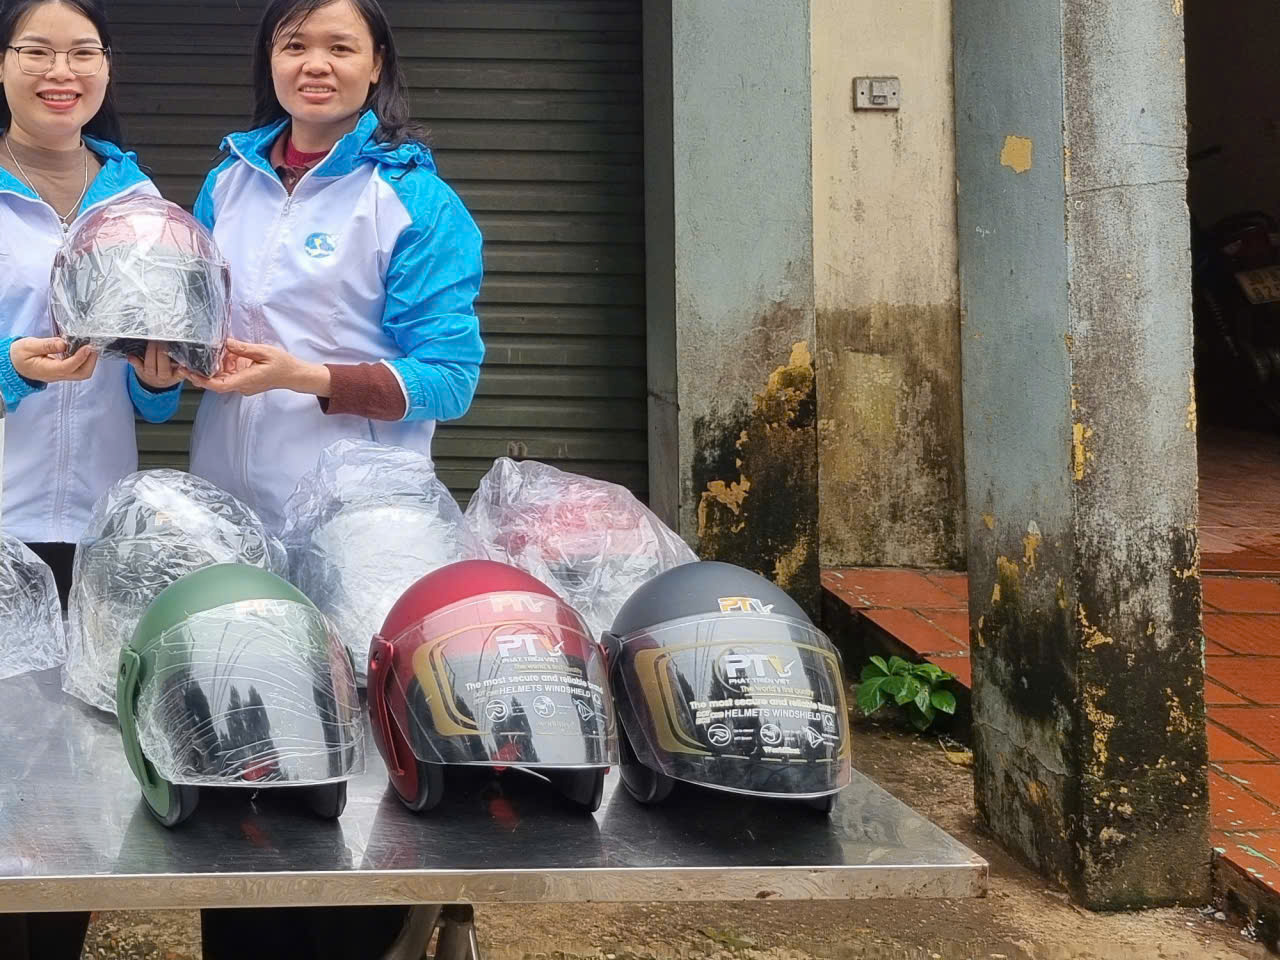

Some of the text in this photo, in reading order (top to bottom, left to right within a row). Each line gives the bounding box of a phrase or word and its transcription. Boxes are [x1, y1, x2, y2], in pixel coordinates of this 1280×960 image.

[483, 677, 506, 687] most
[508, 674, 539, 683] secure
[541, 673, 558, 682] and
[499, 684, 591, 698] HELMETS WINDSHIELD
[690, 701, 707, 710] The
[725, 709, 770, 718] HELMETS
[772, 709, 821, 721] WINDSHIELD
